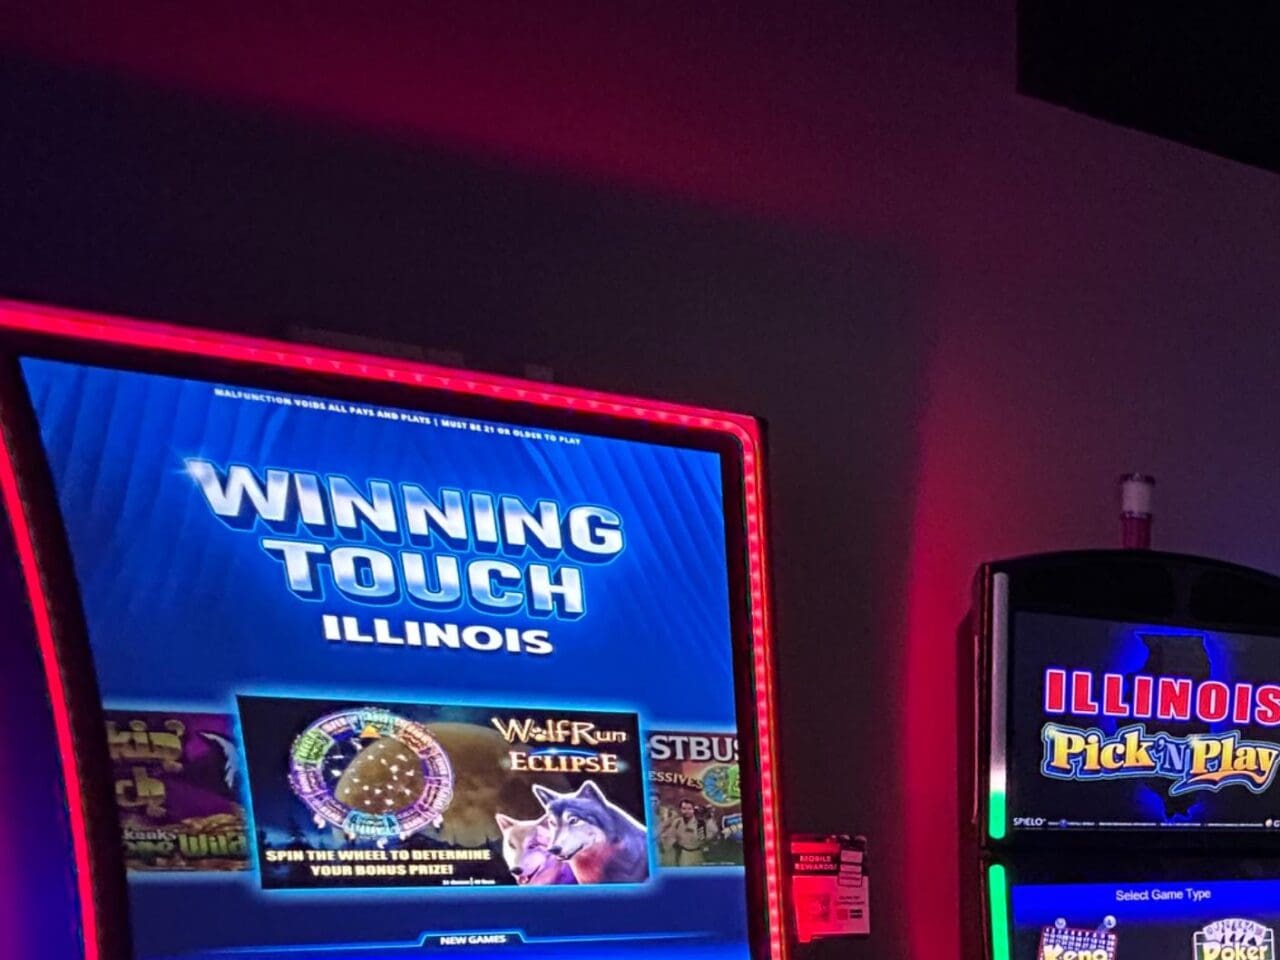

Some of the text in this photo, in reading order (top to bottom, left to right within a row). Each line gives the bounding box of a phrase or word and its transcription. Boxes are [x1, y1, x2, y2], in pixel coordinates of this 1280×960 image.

[214, 387, 581, 446] MALFUNCTION VOIDS ALL PAYS AND PLAYS MUST BE 21 OR OLDER TO PLAY
[187, 459, 625, 562] WINNING
[262, 538, 585, 619] TOUCH
[322, 614, 555, 656] ILLINOIS
[509, 751, 620, 774] ECLIPSE
[1050, 730, 1154, 771] Pick
[1189, 736, 1280, 785] Play
[1013, 816, 1043, 827] SPIELO
[266, 849, 491, 862] SPIN THE WHEEL TO DETERMINE
[310, 864, 454, 877] YOUR BONUS PRIZE!
[1116, 888, 1212, 902] Select Game Type
[440, 934, 507, 946] NEW GAMES
